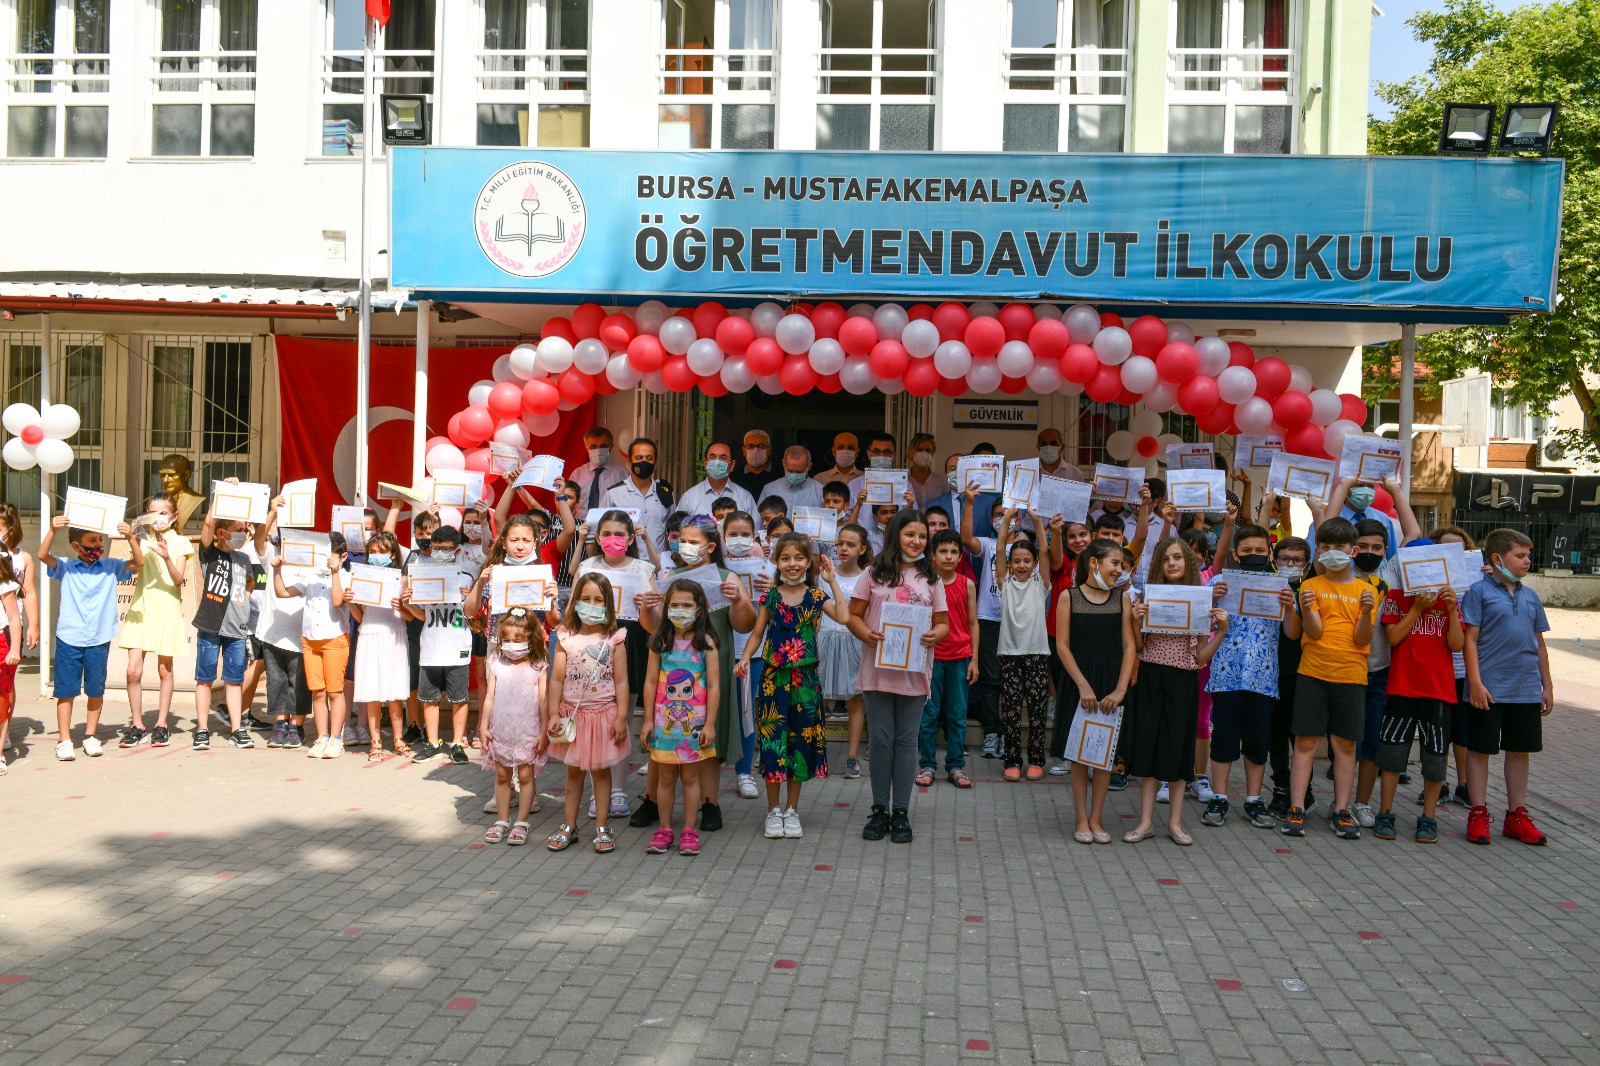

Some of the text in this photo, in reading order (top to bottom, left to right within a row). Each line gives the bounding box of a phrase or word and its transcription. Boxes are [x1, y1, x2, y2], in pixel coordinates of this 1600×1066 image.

[480, 166, 581, 214] T.C. MİLLİ EĞİTİM BAKANLIĞI
[636, 174, 735, 200] BURSA
[763, 176, 1088, 210] MUSTAFAKEMALPAŞA
[634, 213, 1453, 283] ÖĞRETMENDAVUT İLKOKULU
[969, 406, 1024, 421] GÜVENLİK
